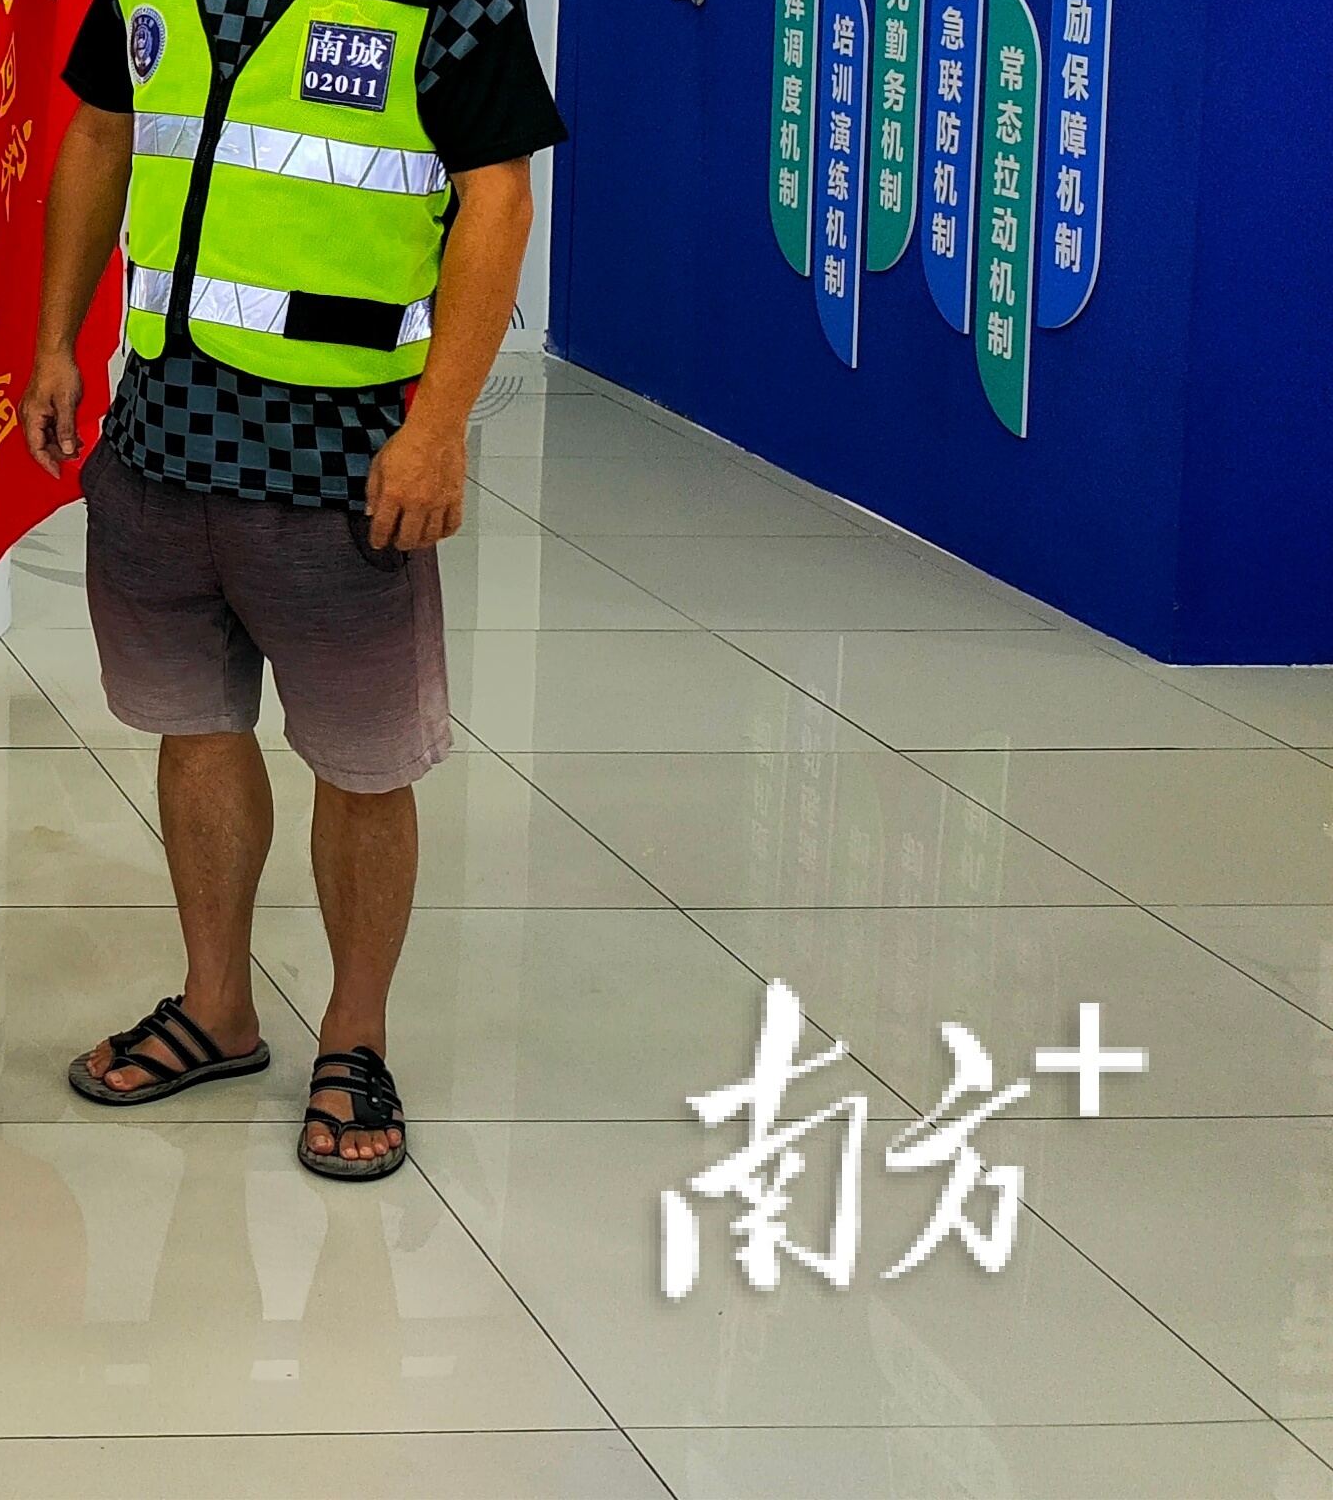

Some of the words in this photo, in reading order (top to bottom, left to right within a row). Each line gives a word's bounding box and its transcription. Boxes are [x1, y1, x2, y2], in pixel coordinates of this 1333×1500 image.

[304, 74, 378, 99] 02011
[308, 30, 388, 71] 南城
[823, 15, 856, 299] 培训演练机制
[987, 46, 1025, 360] 常态拉动机制
